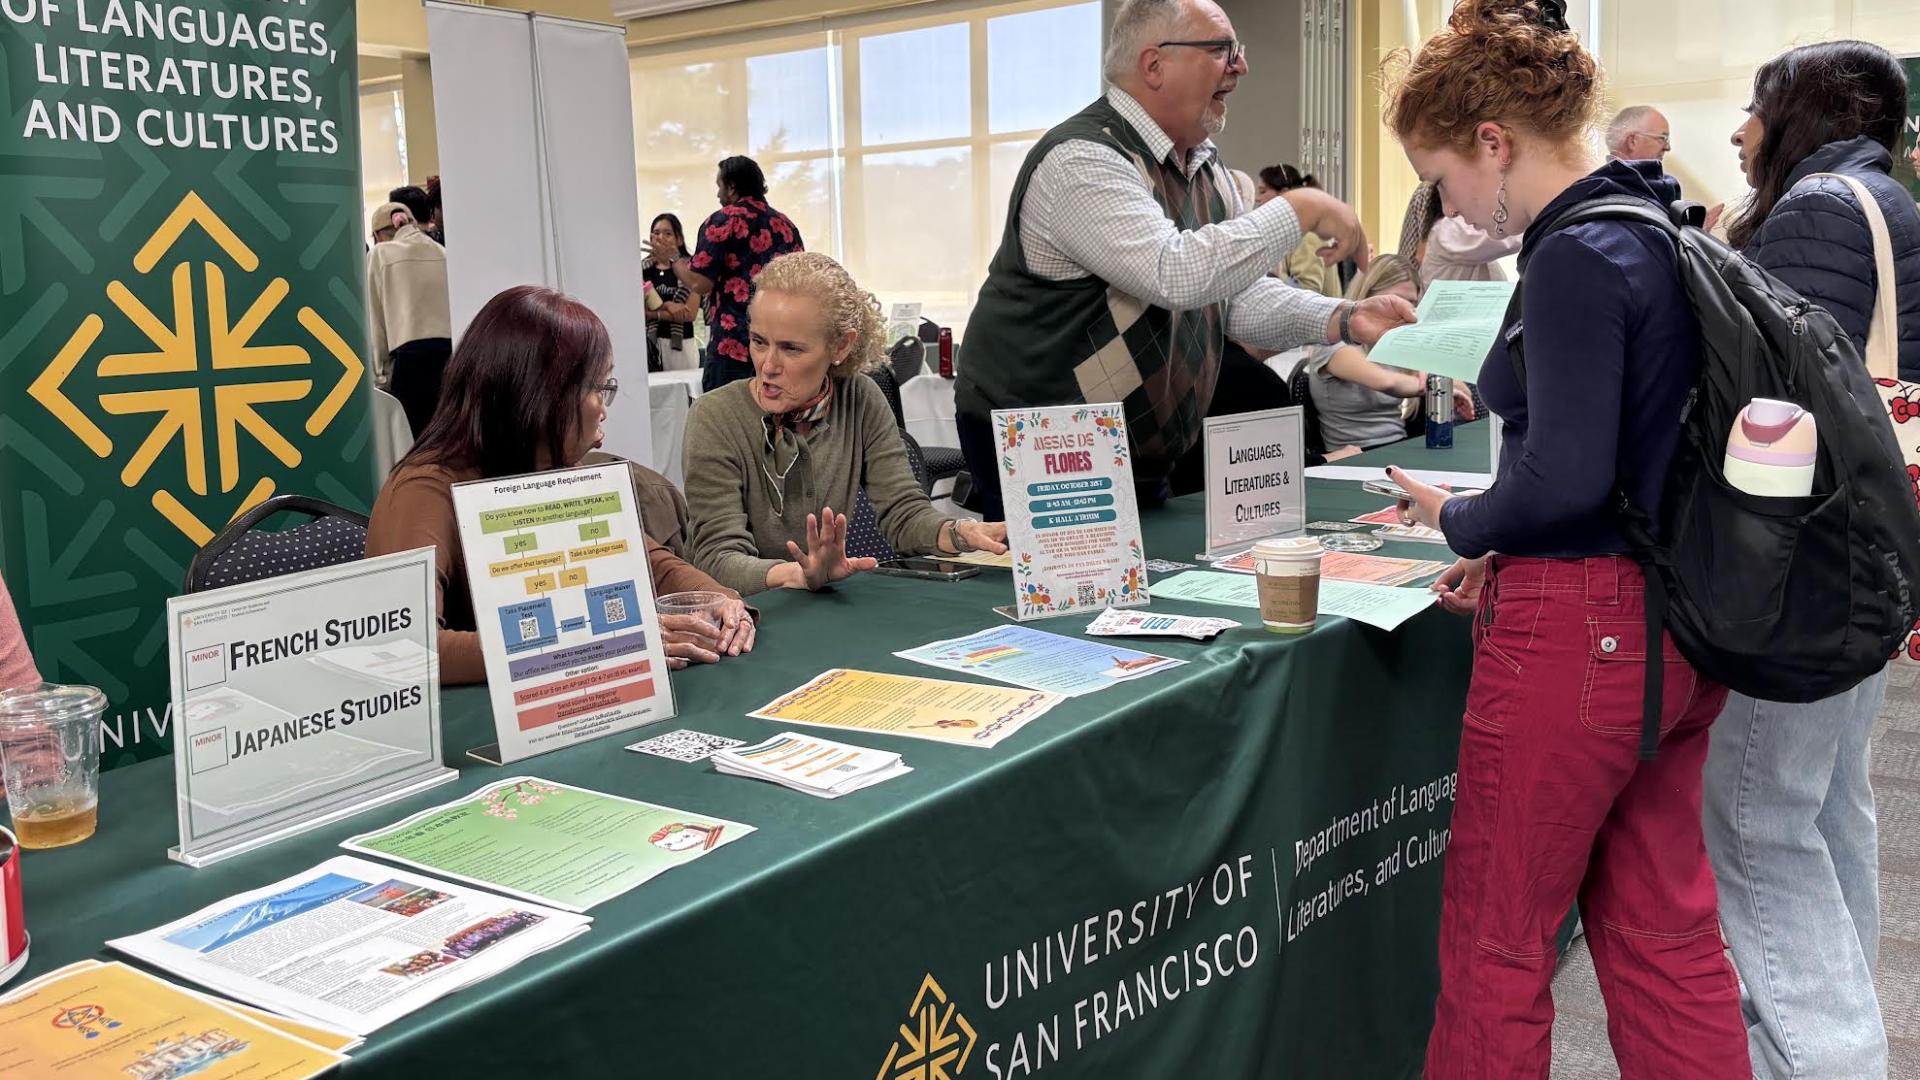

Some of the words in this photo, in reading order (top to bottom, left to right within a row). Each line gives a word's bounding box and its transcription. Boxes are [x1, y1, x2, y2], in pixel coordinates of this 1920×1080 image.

[2, 0, 60, 26] OF
[77, 0, 337, 64] LANGUAGES,
[35, 43, 322, 110] LITERATURES,
[24, 99, 121, 143] AND
[136, 109, 339, 154] CULTURES
[1043, 451, 1093, 475] FLORES
[1229, 443, 1285, 465] LANGUAGES,
[493, 483, 521, 494] Foreign
[522, 478, 556, 491] Language
[556, 472, 601, 485] Requirement
[1224, 472, 1281, 495] LITERATURES
[1283, 471, 1290, 485] &
[512, 516, 535, 526] LISTEN
[1235, 501, 1281, 522] CULTURES
[513, 539, 527, 549] yes
[533, 579, 547, 589] yes
[192, 649, 220, 663] MINOR
[230, 629, 318, 671] FRENCH
[325, 607, 412, 647] STUDIES
[195, 732, 223, 748] MINOR
[232, 708, 336, 759] JAPANESE
[341, 685, 422, 726] STUDIES
[1295, 798, 1379, 877] Department
[1382, 786, 1396, 824] of
[1400, 772, 1458, 816] Languag
[1287, 868, 1369, 943] Literatures,
[1375, 841, 1401, 886] and
[1406, 828, 1452, 868] Cultur
[985, 876, 1204, 1010] UNIVERSITY
[1212, 854, 1252, 906] OF
[985, 1014, 1059, 1080] SAN
[1074, 925, 1258, 1050] FRANCISCO
